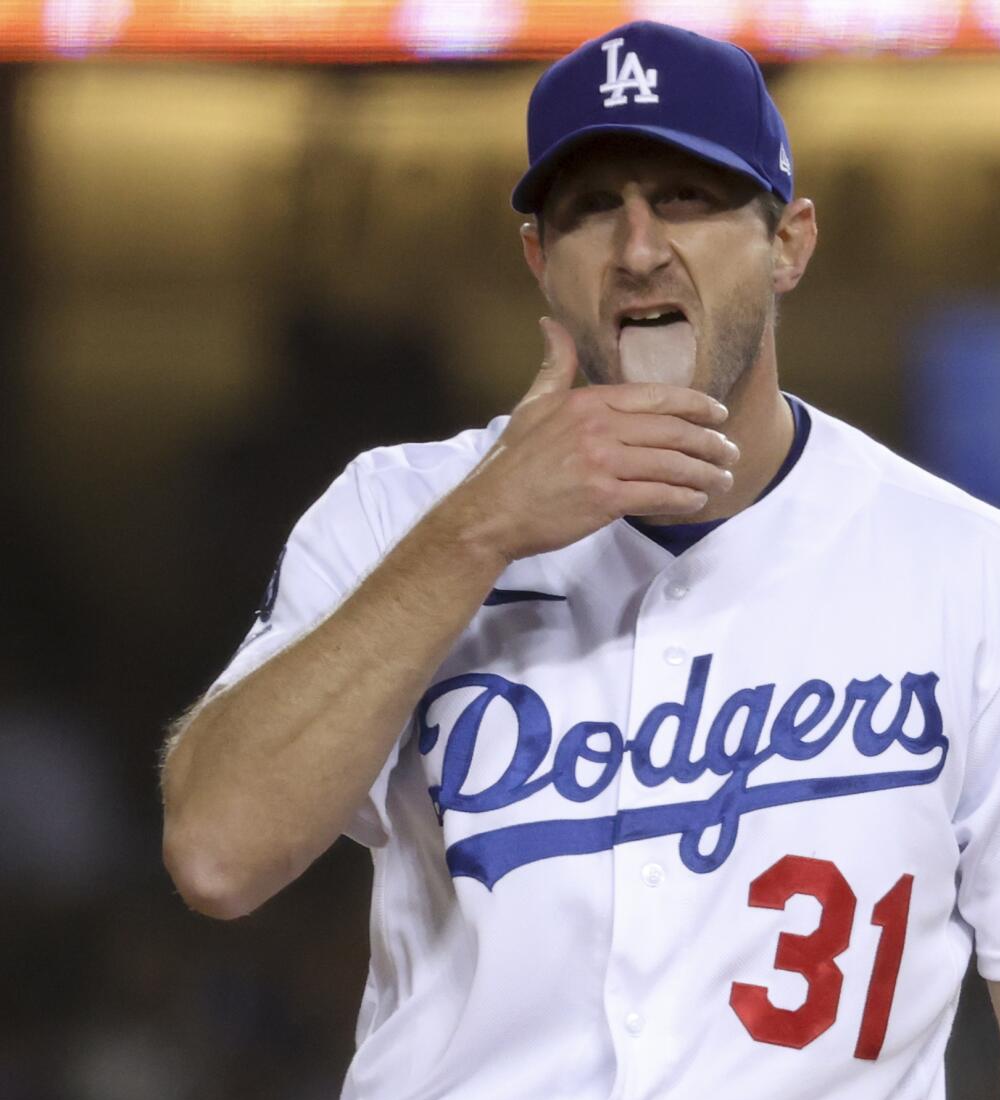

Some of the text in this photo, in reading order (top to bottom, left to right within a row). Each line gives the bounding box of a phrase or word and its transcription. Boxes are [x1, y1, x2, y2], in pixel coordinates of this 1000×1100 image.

[600, 38, 659, 107] LA
[418, 653, 949, 877] Dodgers
[729, 854, 914, 1060] 31
